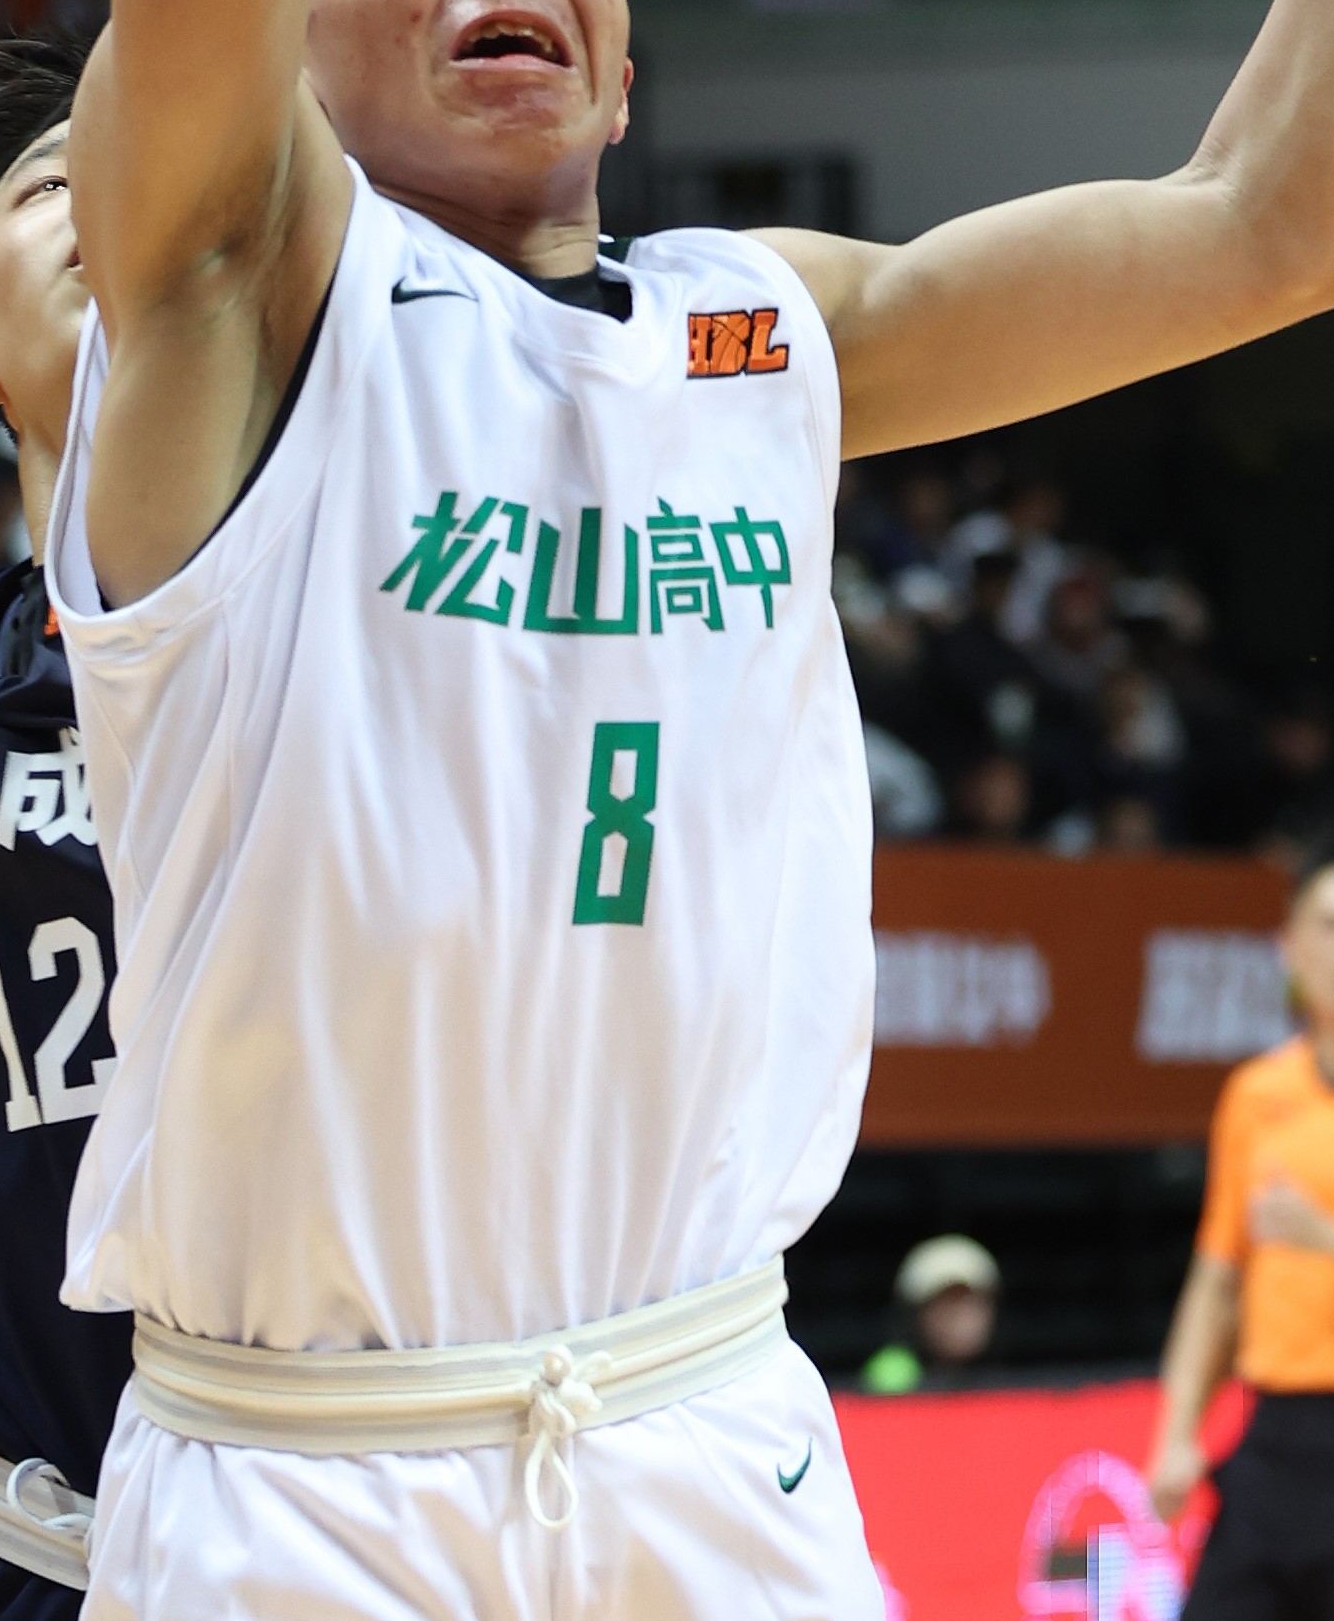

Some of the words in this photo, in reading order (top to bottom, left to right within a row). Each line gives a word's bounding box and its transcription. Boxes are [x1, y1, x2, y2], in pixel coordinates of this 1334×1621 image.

[379, 489, 792, 636] 松山高中
[572, 720, 661, 927] 8
